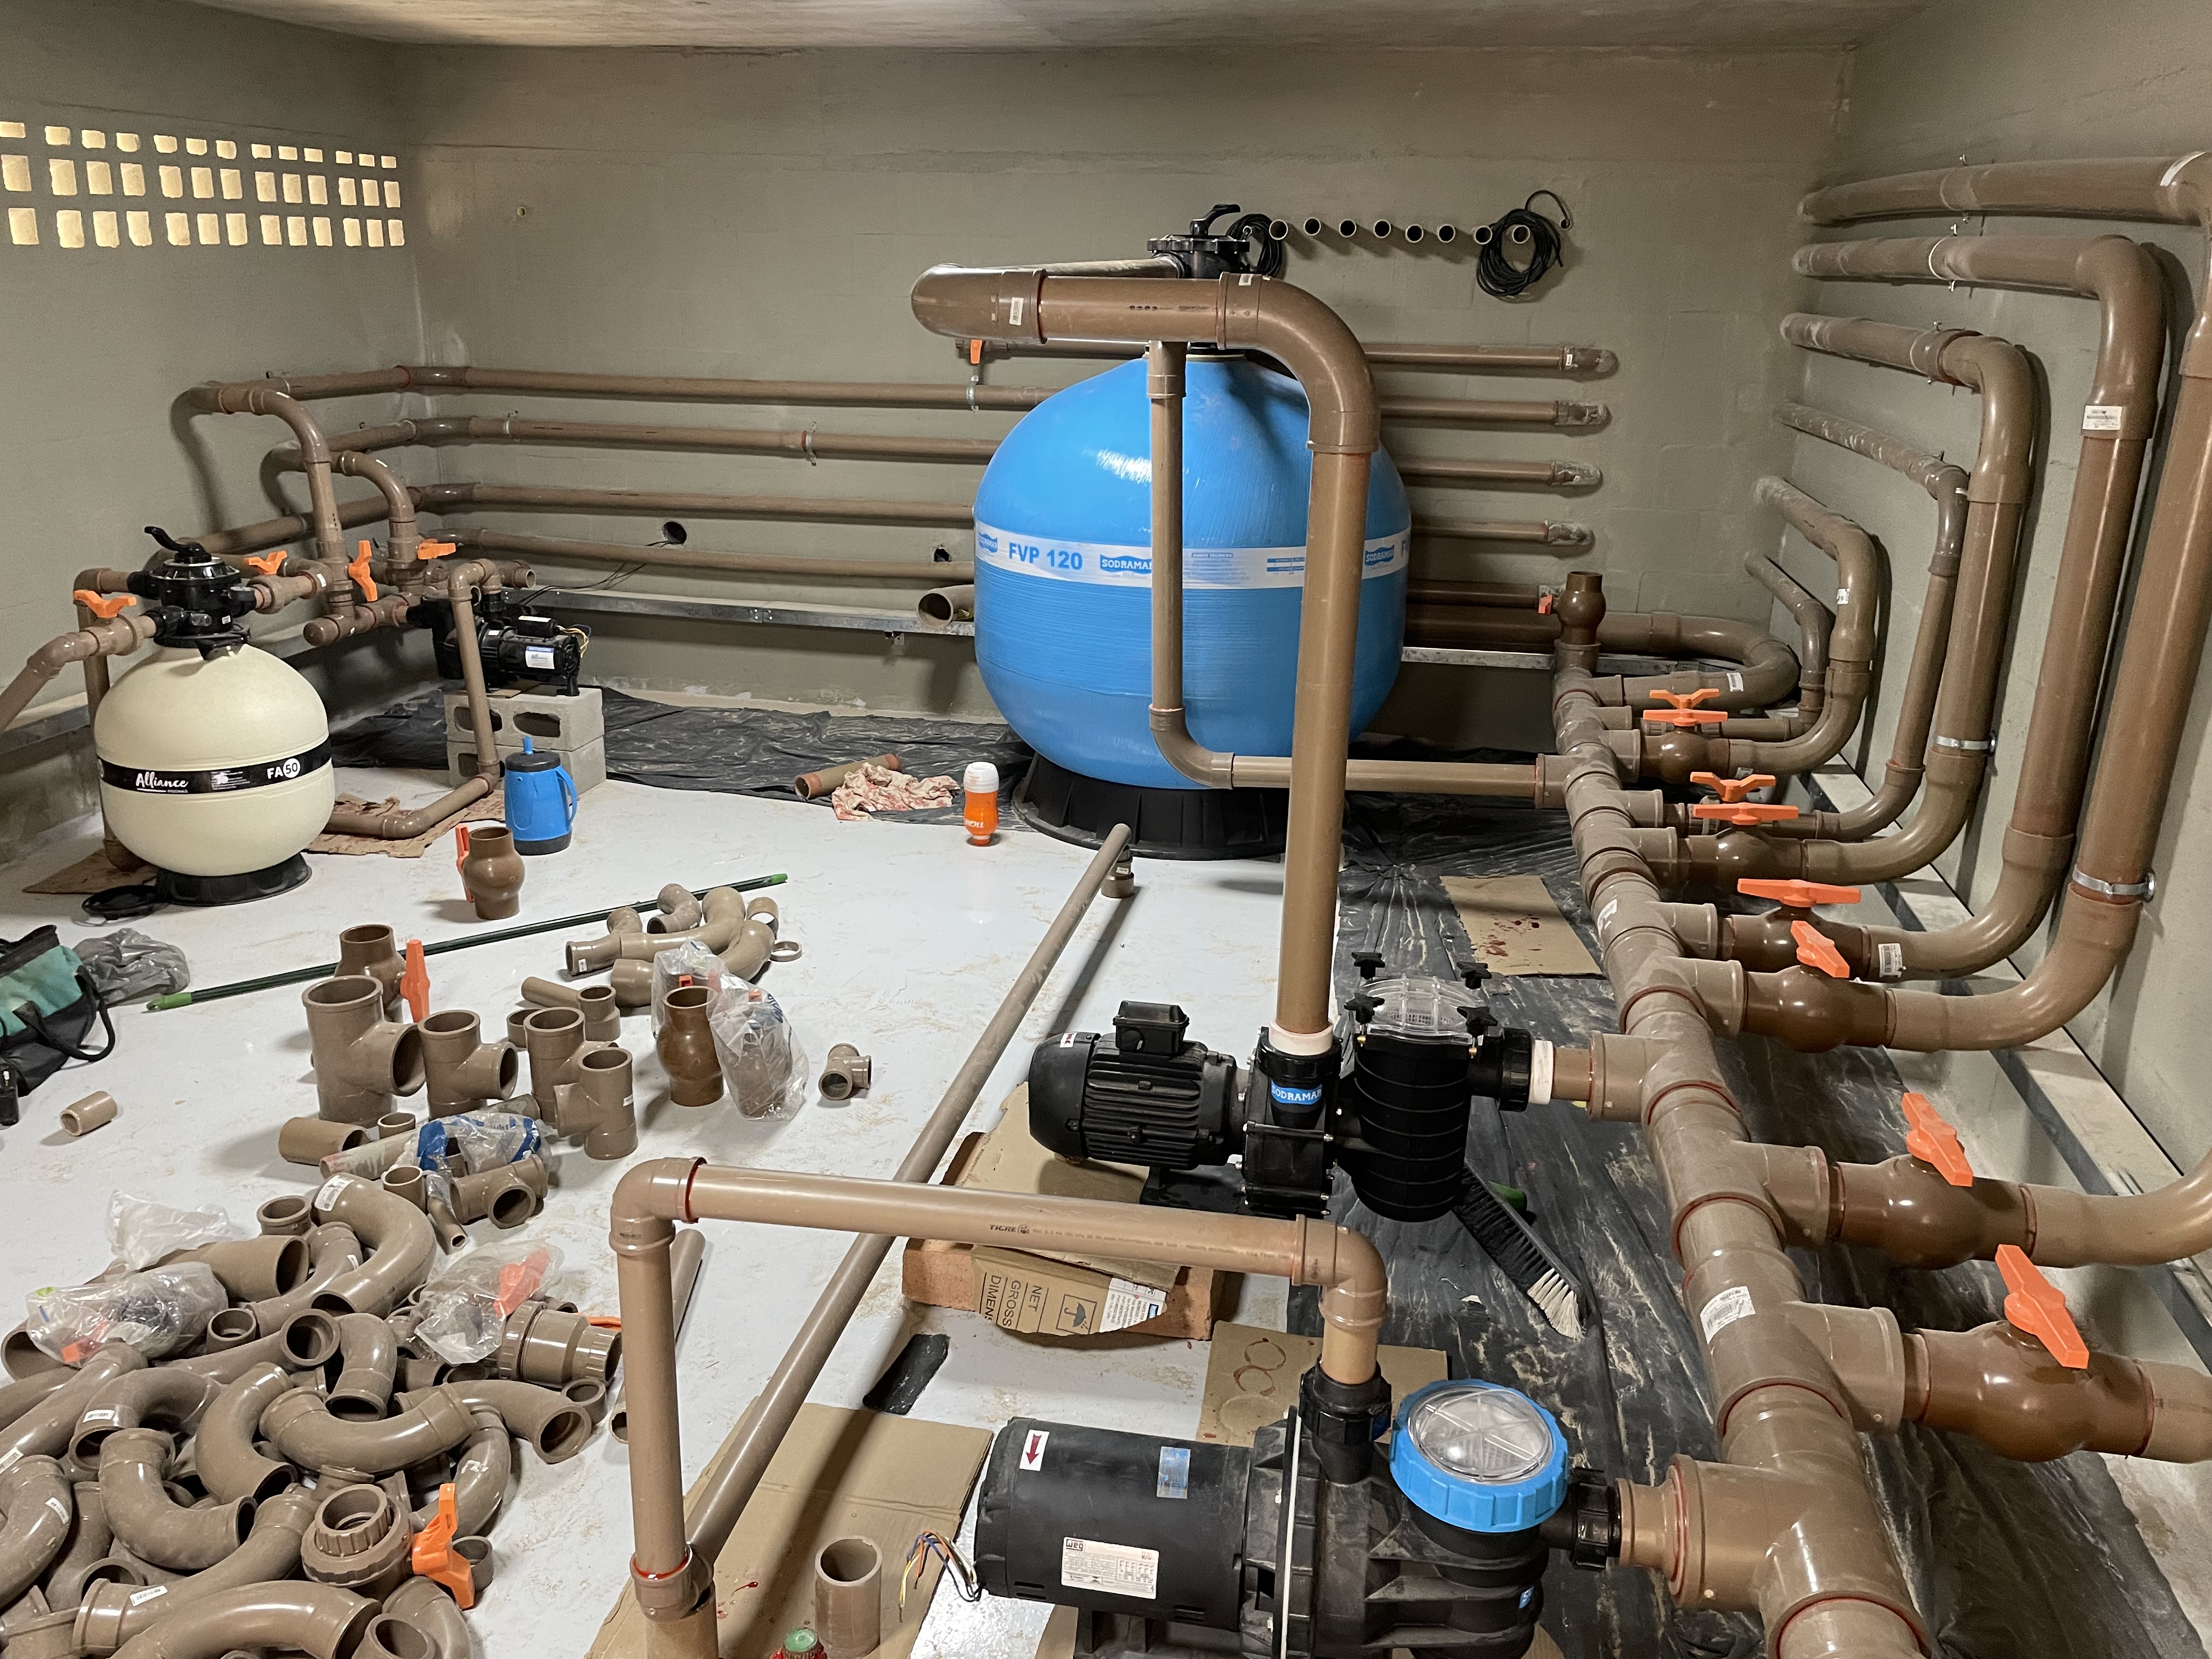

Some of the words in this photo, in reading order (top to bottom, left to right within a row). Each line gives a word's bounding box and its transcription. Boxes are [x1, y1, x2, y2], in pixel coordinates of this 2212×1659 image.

[1009, 542, 1040, 564] FVP
[1046, 550, 1083, 570] 120
[136, 771, 189, 788] Alliance
[1271, 1084, 1322, 1102] SODRAMAR
[989, 1224, 1017, 1233] TIGRE
[1002, 1280, 1022, 1327] GROSS
[1028, 1285, 1043, 1312] NET
